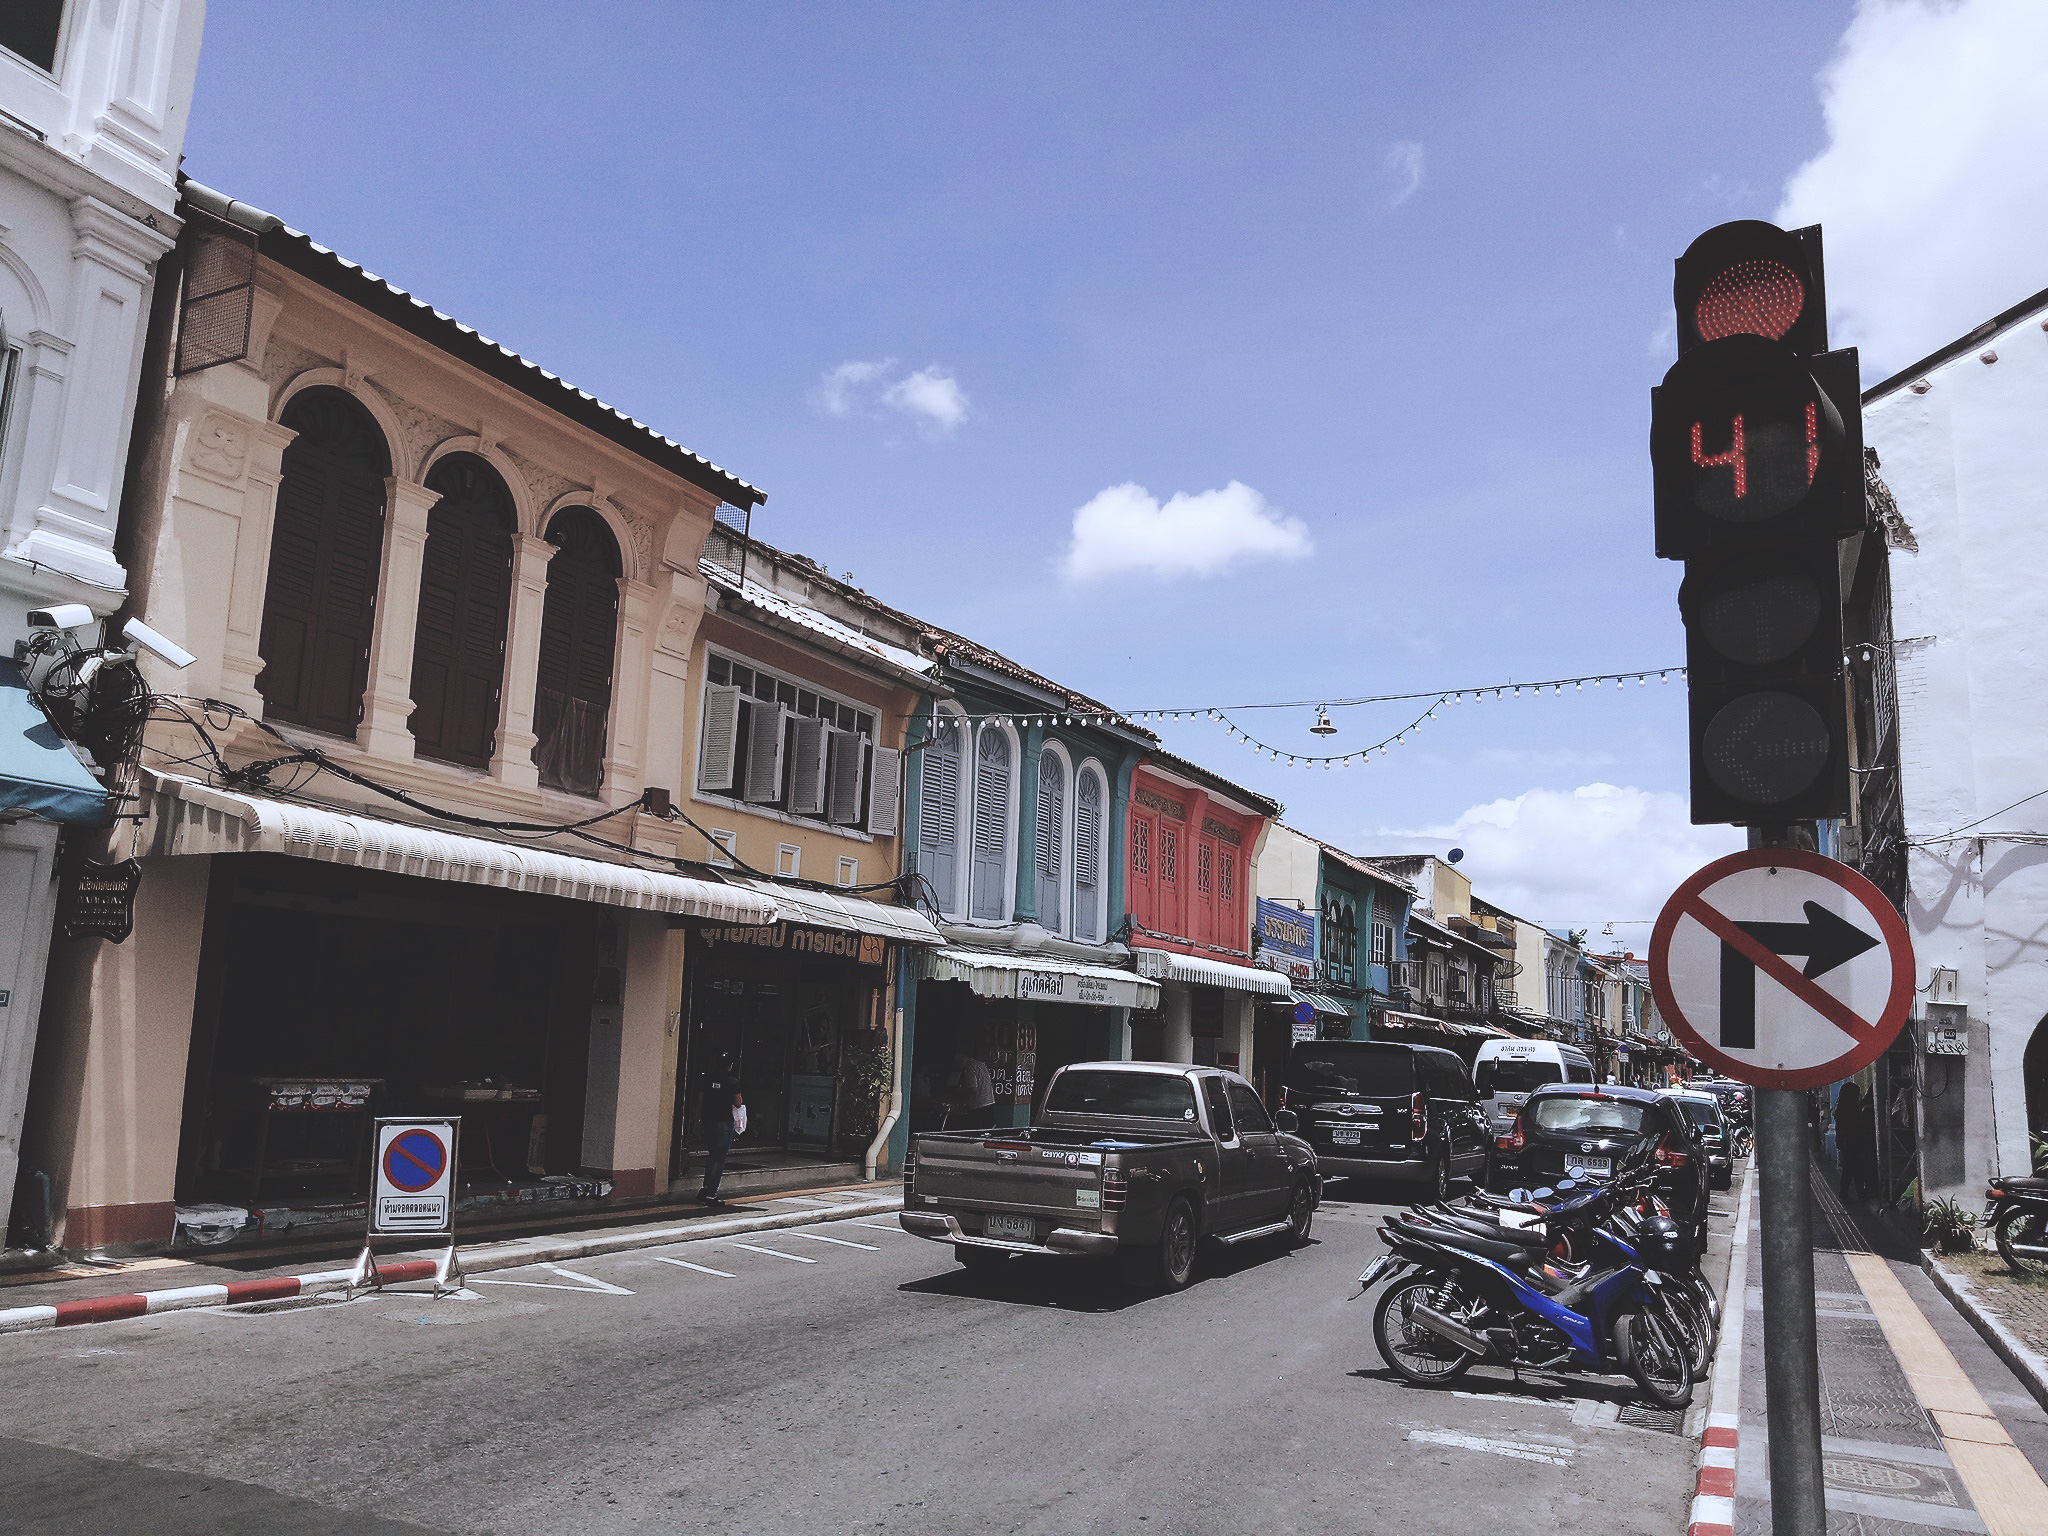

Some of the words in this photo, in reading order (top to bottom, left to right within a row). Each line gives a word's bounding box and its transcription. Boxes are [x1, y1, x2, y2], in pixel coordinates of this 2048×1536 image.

[1690, 401, 1821, 499] 41
[792, 929, 857, 958] การแว่น
[384, 1200, 441, 1214] ห้ามจอดตลอดแนว
